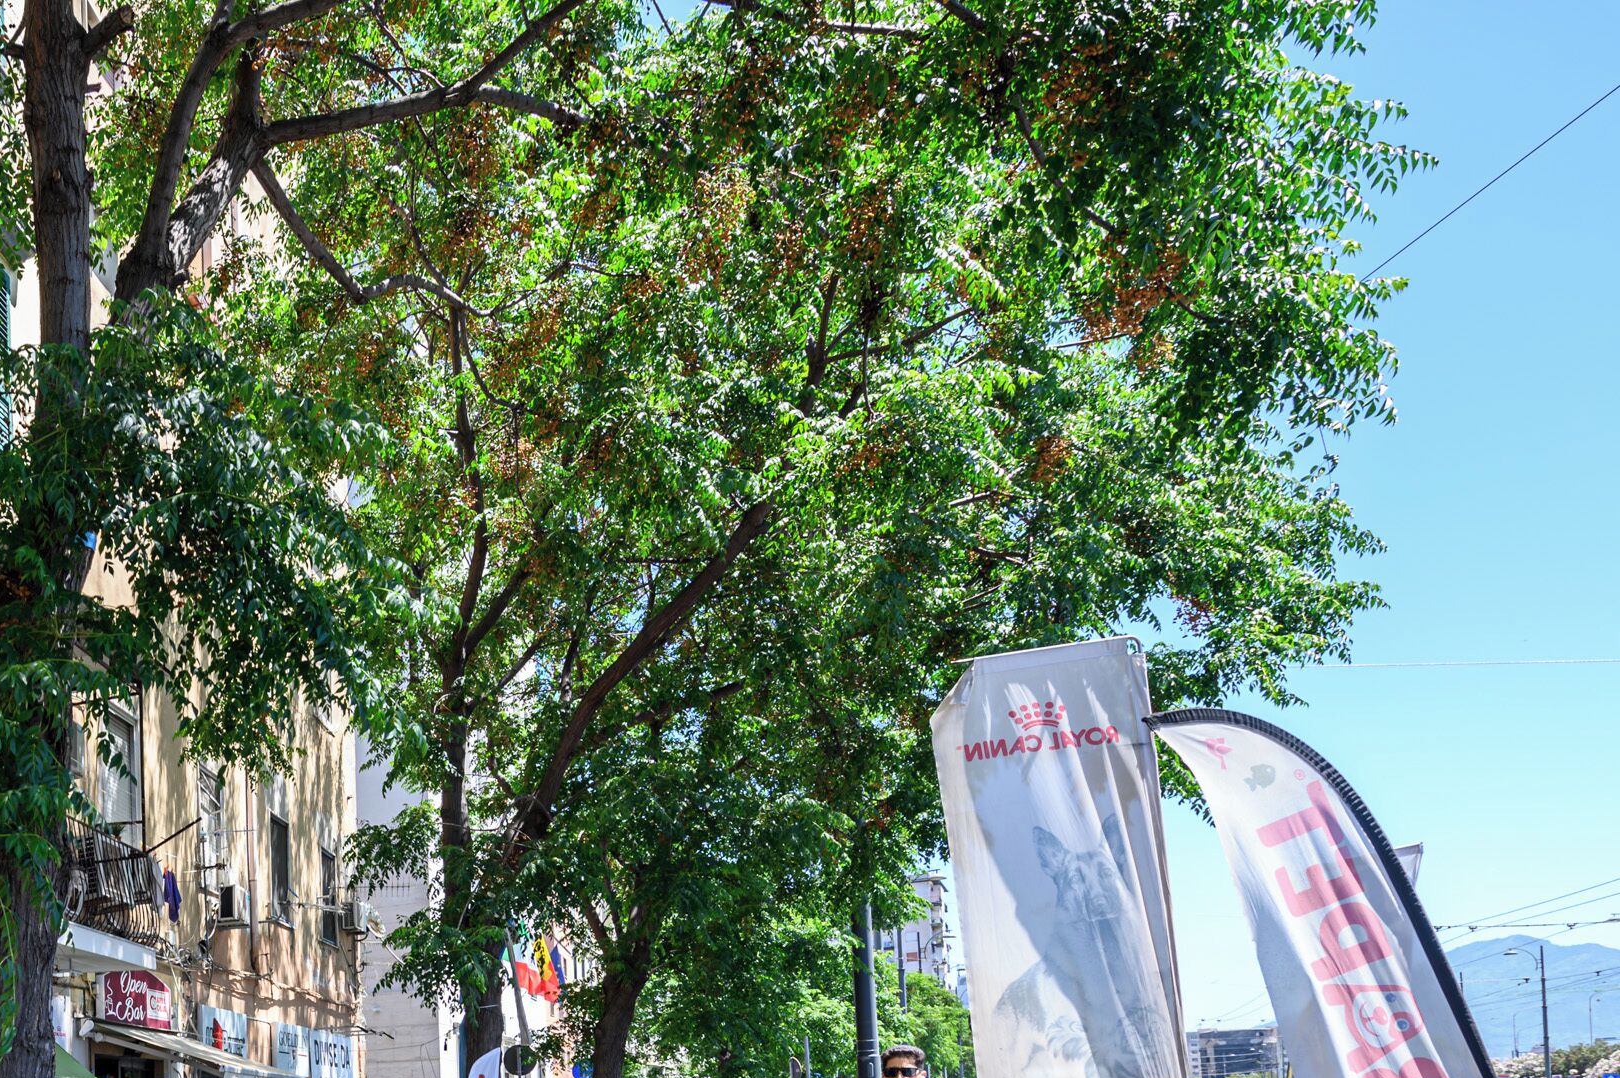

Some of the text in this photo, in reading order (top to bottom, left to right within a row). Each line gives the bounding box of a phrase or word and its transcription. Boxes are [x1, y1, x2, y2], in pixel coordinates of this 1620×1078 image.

[120, 970, 147, 996] Open
[116, 997, 146, 1022] Bar
[314, 1039, 337, 1067] DIVISE
[341, 1044, 351, 1069] DA
